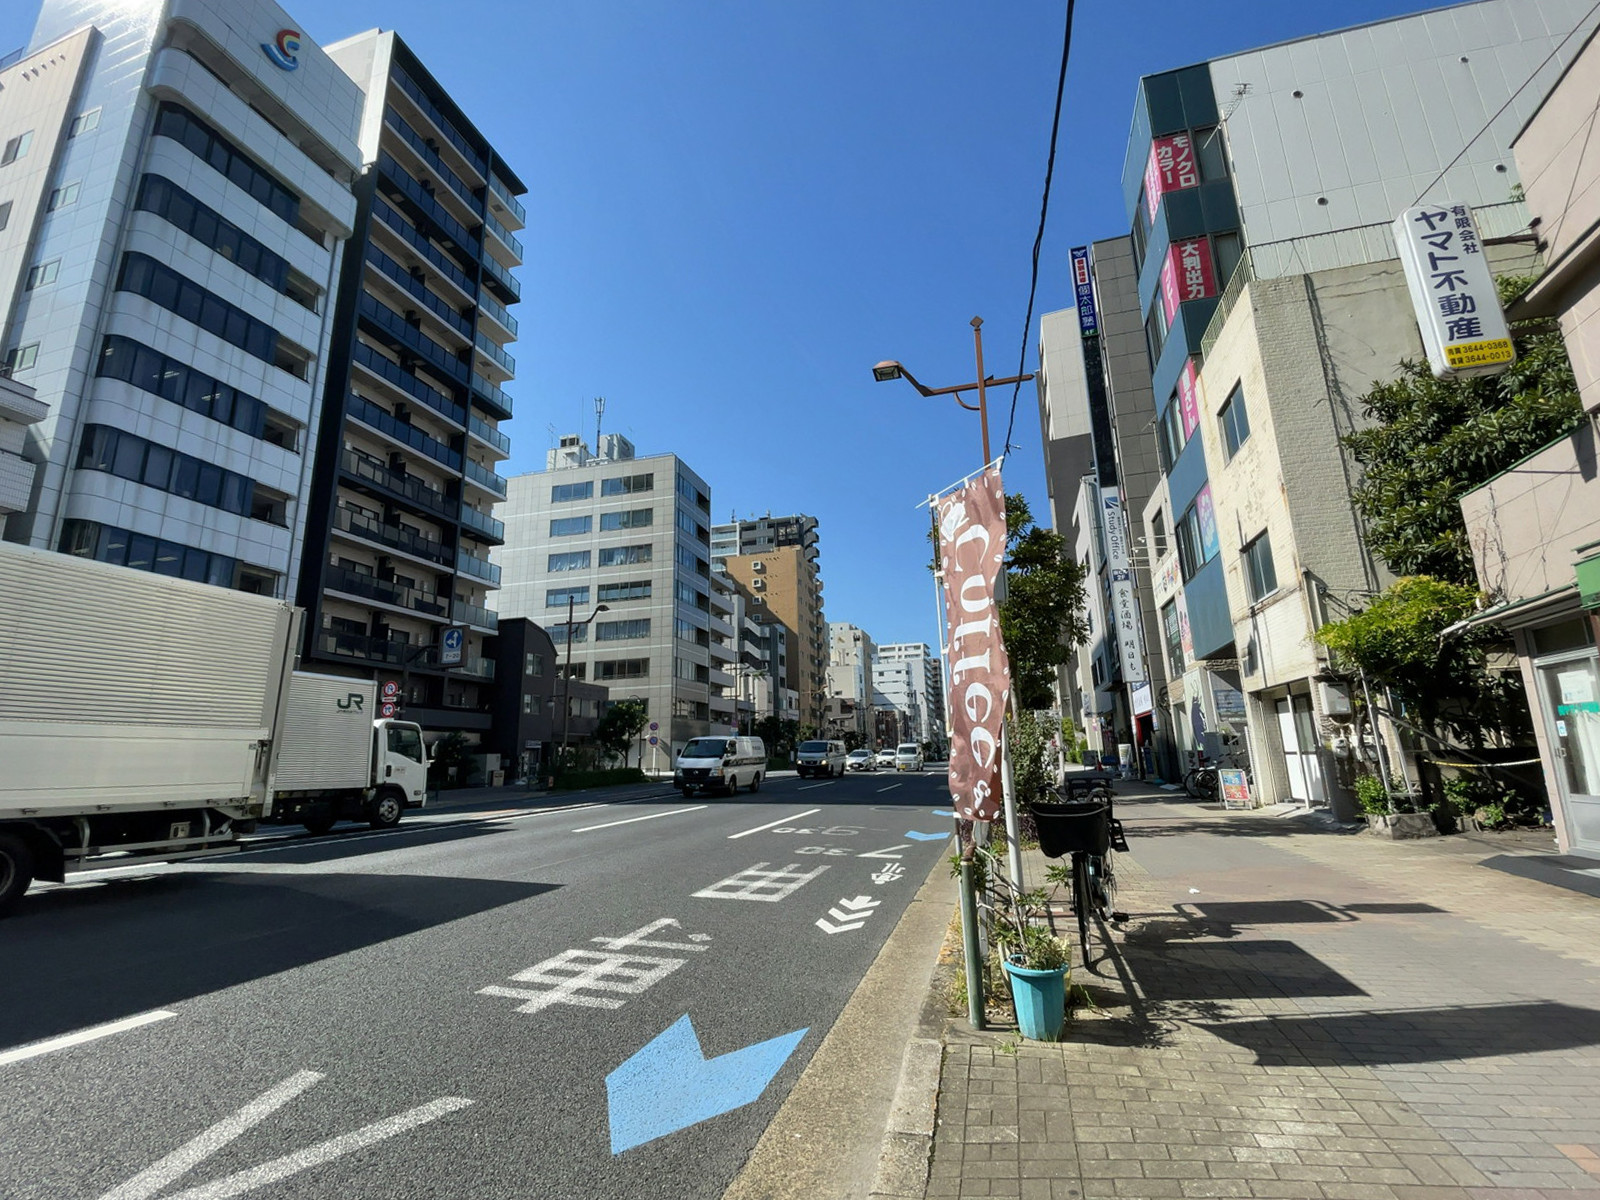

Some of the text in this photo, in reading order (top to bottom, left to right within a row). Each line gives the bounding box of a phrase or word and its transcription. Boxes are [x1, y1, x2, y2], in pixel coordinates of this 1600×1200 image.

[1157, 146, 1174, 184] カラー
[1172, 135, 1196, 187] モノクロ
[1451, 205, 1479, 254] 有限会社
[1181, 242, 1204, 299] 大判出力
[1414, 211, 1483, 341] ヤマト不動産
[1462, 341, 1508, 353] 3644-0368
[1464, 350, 1511, 363] 3644-0013
[1118, 588, 1133, 630] 食堂酒場
[337, 693, 364, 710] JR
